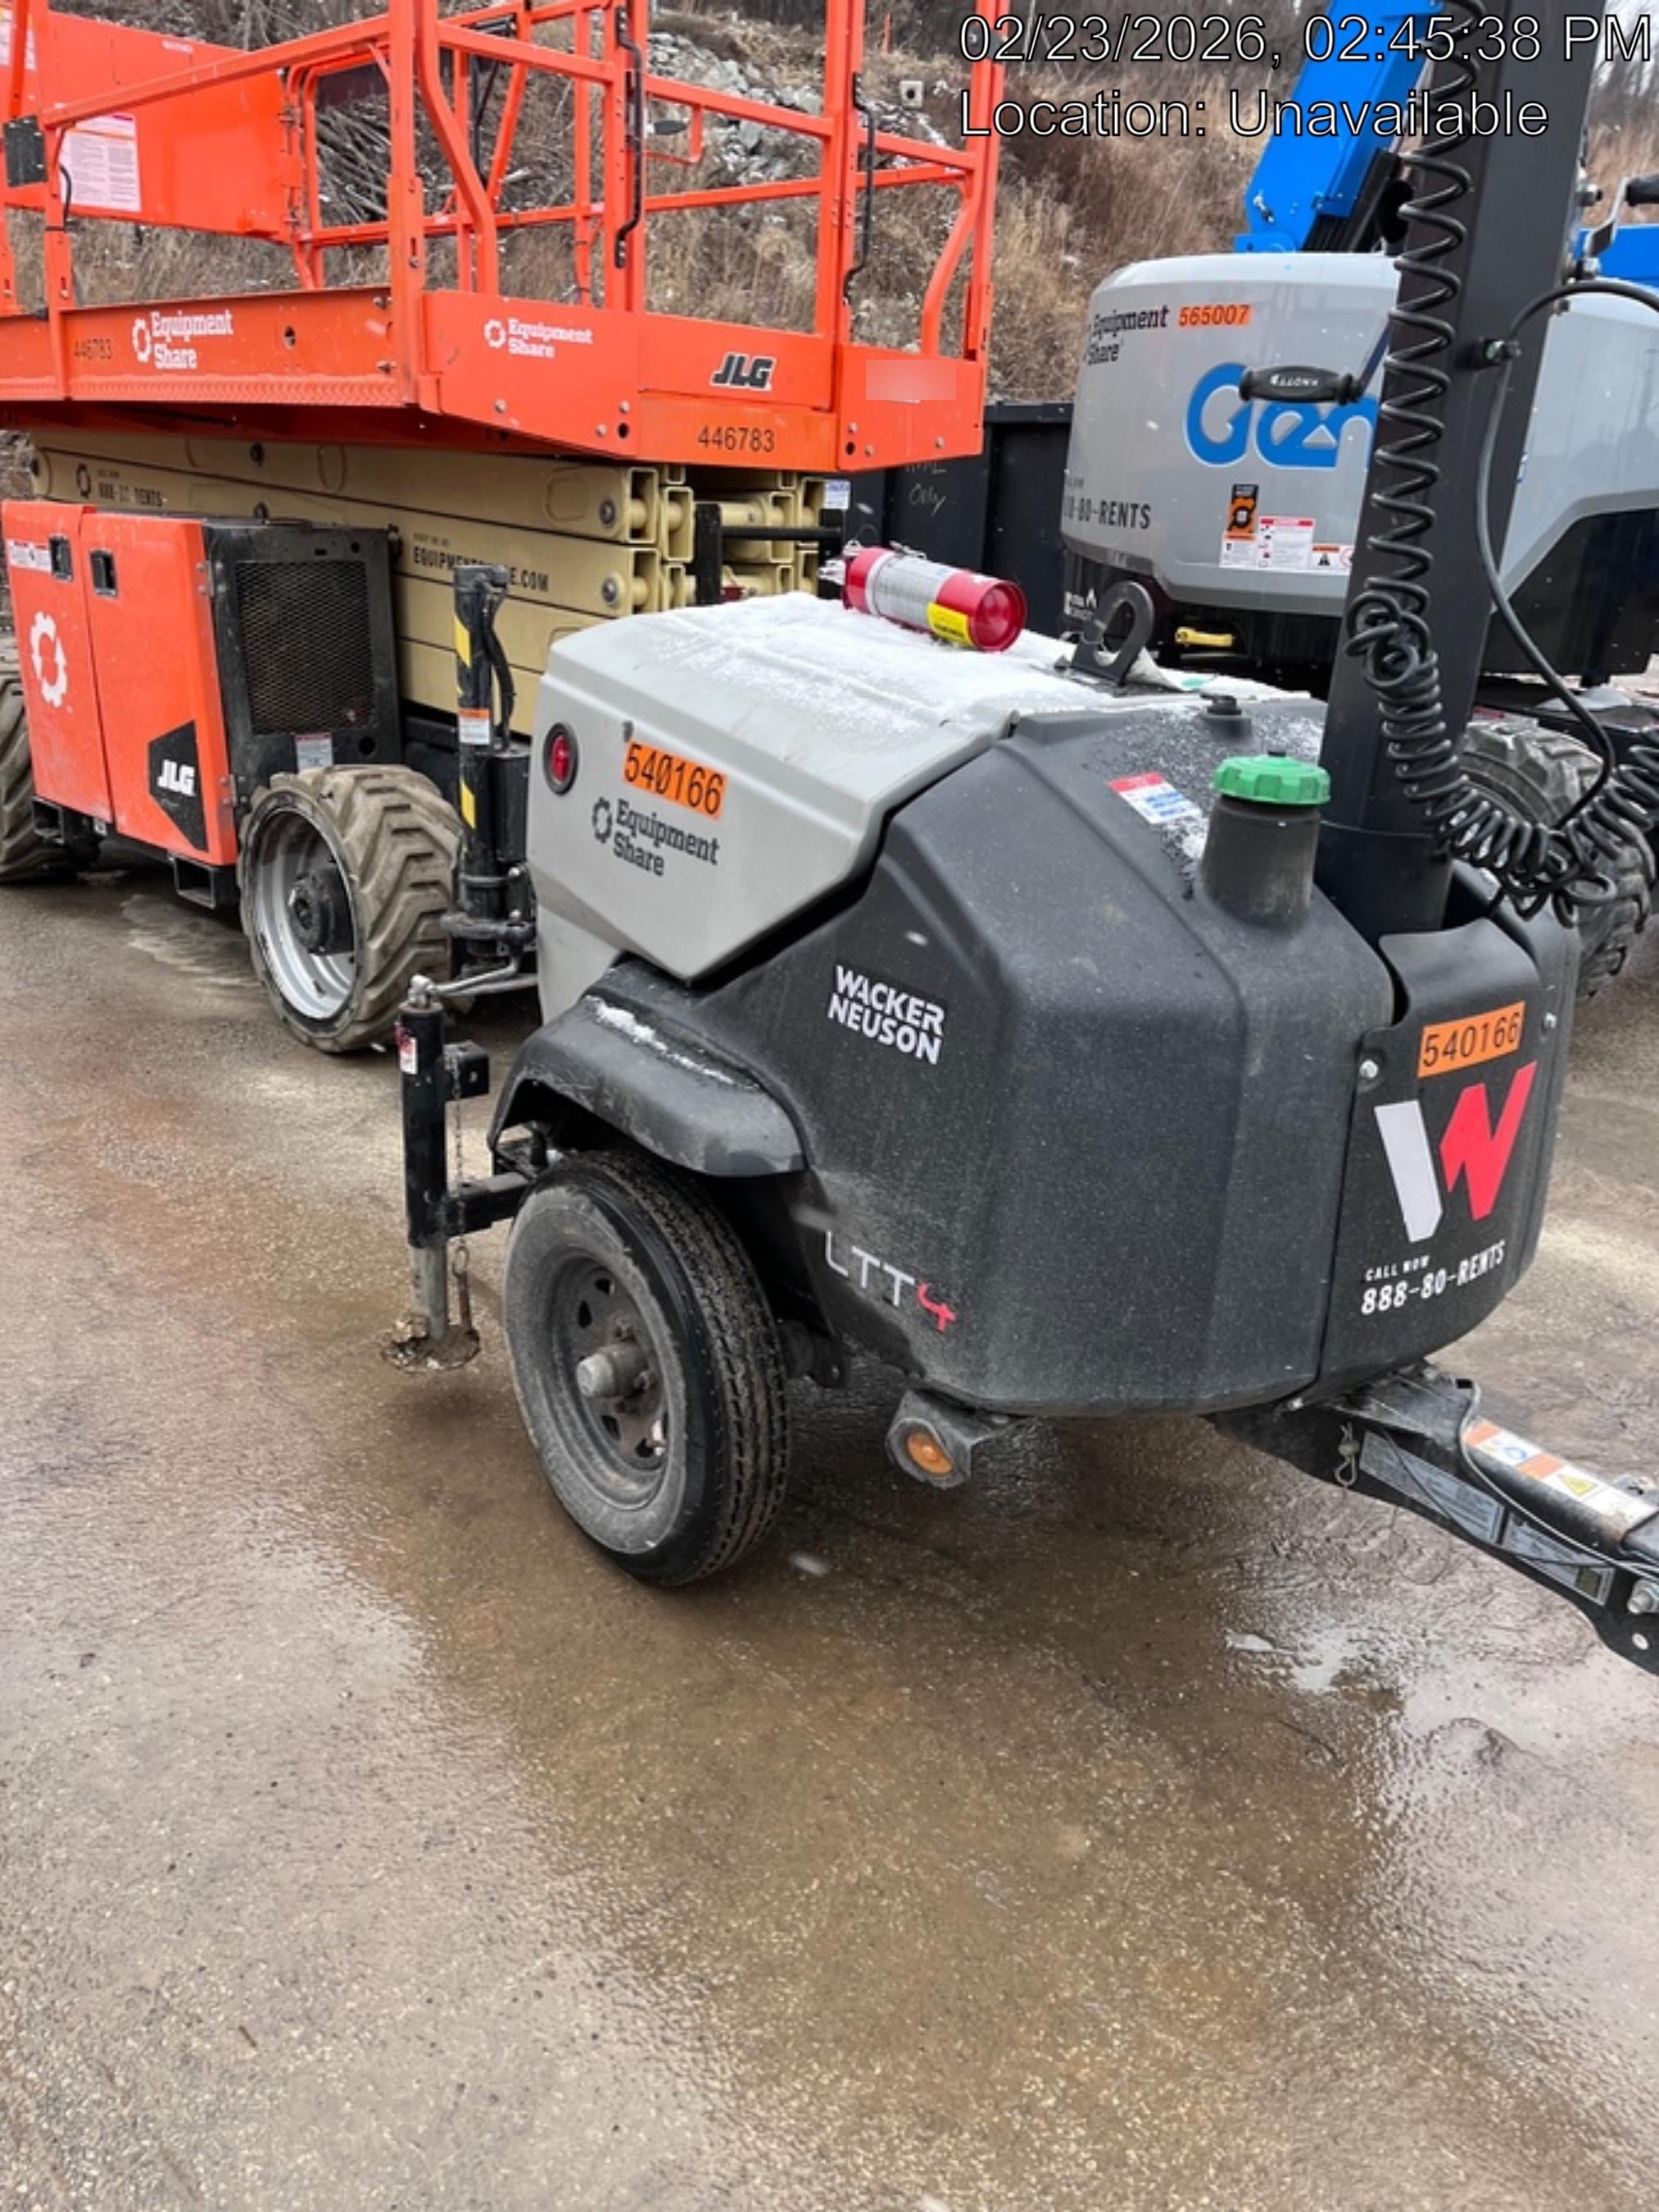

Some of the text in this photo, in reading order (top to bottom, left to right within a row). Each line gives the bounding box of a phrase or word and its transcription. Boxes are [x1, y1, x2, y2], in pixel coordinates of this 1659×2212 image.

[150, 310, 234, 342] Equipment
[507, 317, 593, 344] Equipment
[1178, 304, 1250, 327] 565007
[153, 343, 197, 369] Share
[508, 338, 555, 358] Share
[709, 352, 777, 391] JLG
[698, 425, 774, 452] 446783
[156, 758, 197, 798] JLG
[623, 742, 723, 815] 540166
[616, 797, 720, 865] Equipment
[613, 831, 664, 877] Share
[836, 964, 945, 1036] WACKER
[827, 992, 942, 1065] NEUSON
[1422, 1011, 1521, 1067] 540166
[826, 1231, 957, 1334] LTT4
[1361, 1239, 1506, 1316] 888-80-RENTS
[1365, 1254, 1430, 1282] CALL NOW
